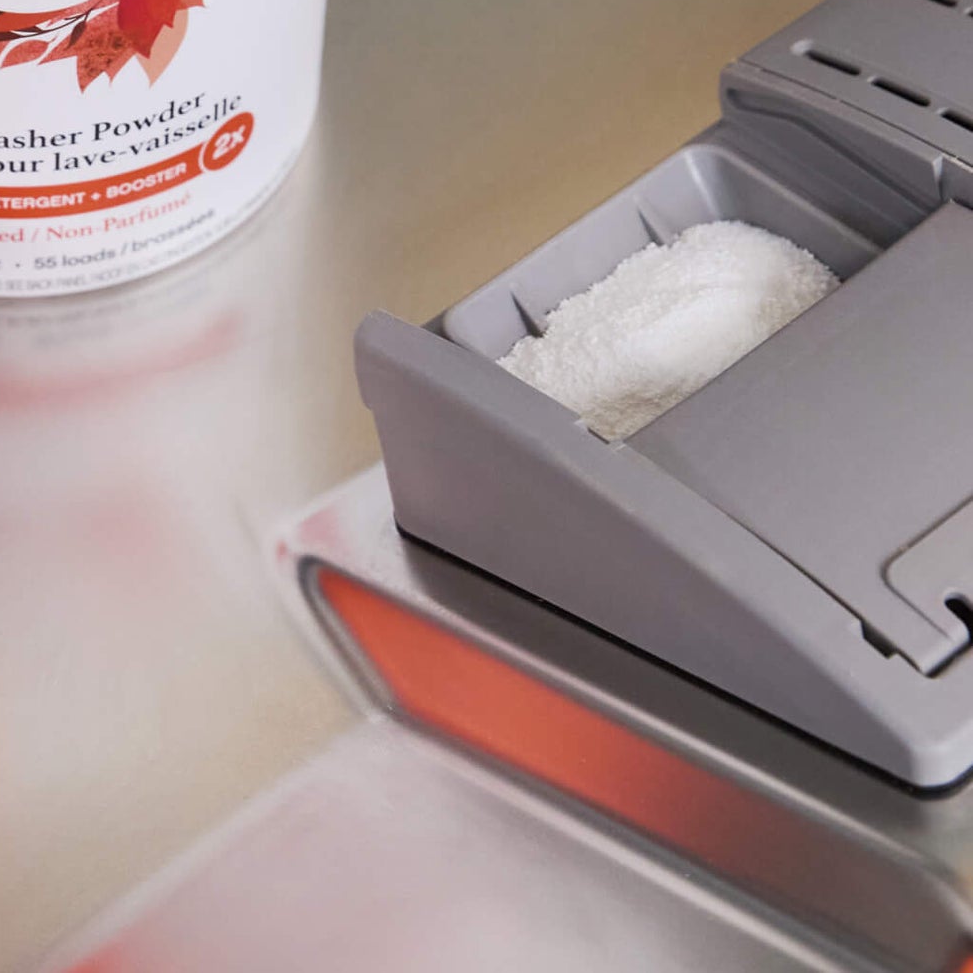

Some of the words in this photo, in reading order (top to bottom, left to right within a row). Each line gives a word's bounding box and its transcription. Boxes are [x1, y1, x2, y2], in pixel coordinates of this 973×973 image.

[53, 95, 242, 171] lave-vaisselle
[93, 93, 206, 142] Powder
[105, 162, 188, 199] BOOSTER
[45, 191, 193, 242] Non-Parfumé
[33, 256, 58, 269] 55
[61, 247, 117, 268] loads
